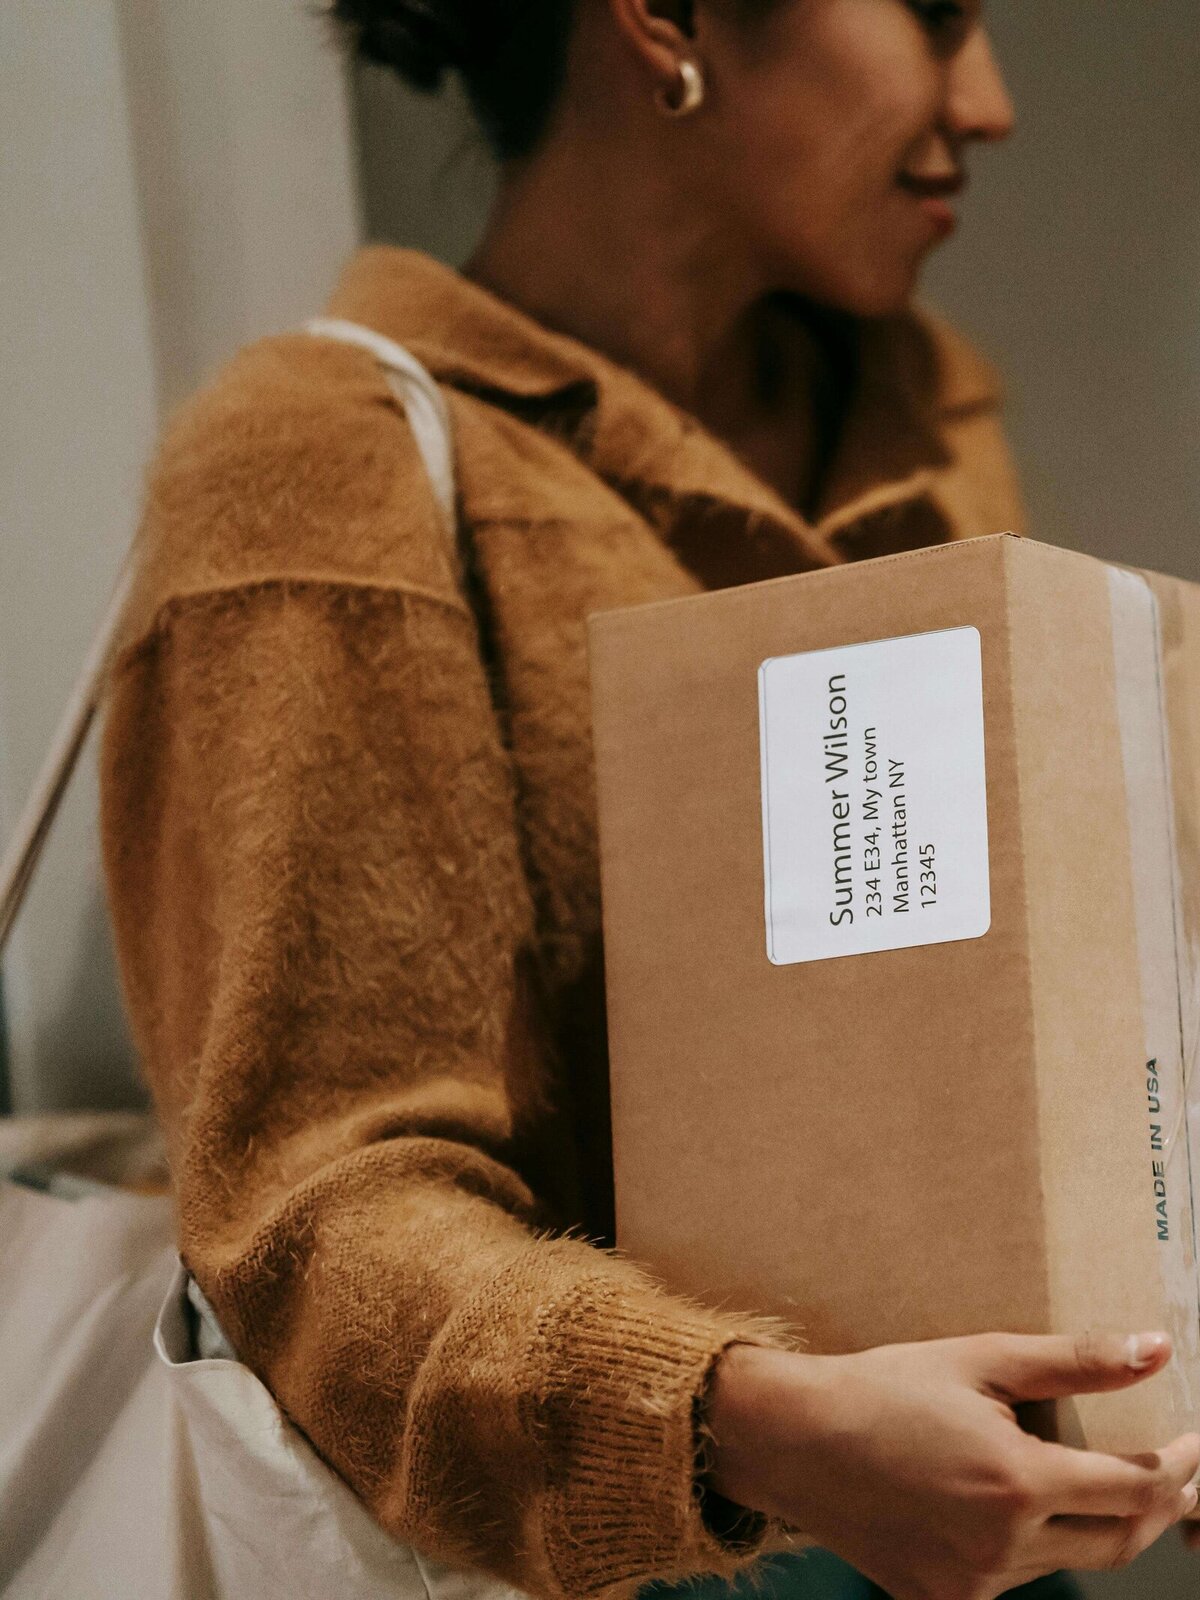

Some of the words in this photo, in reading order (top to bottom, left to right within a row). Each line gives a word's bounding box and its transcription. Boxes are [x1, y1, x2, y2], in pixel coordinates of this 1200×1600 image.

[822, 673, 849, 785] Wilson
[862, 726, 879, 783] town
[888, 758, 905, 789] NY
[862, 788, 883, 821] My
[829, 789, 854, 927] Summer
[863, 826, 882, 872] E34,
[889, 794, 910, 914] Manhattan
[918, 843, 937, 909] 12345
[865, 877, 883, 918] 234
[1145, 1056, 1162, 1114] USA
[1149, 1123, 1163, 1152] IN
[1151, 1160, 1169, 1242] MADE
